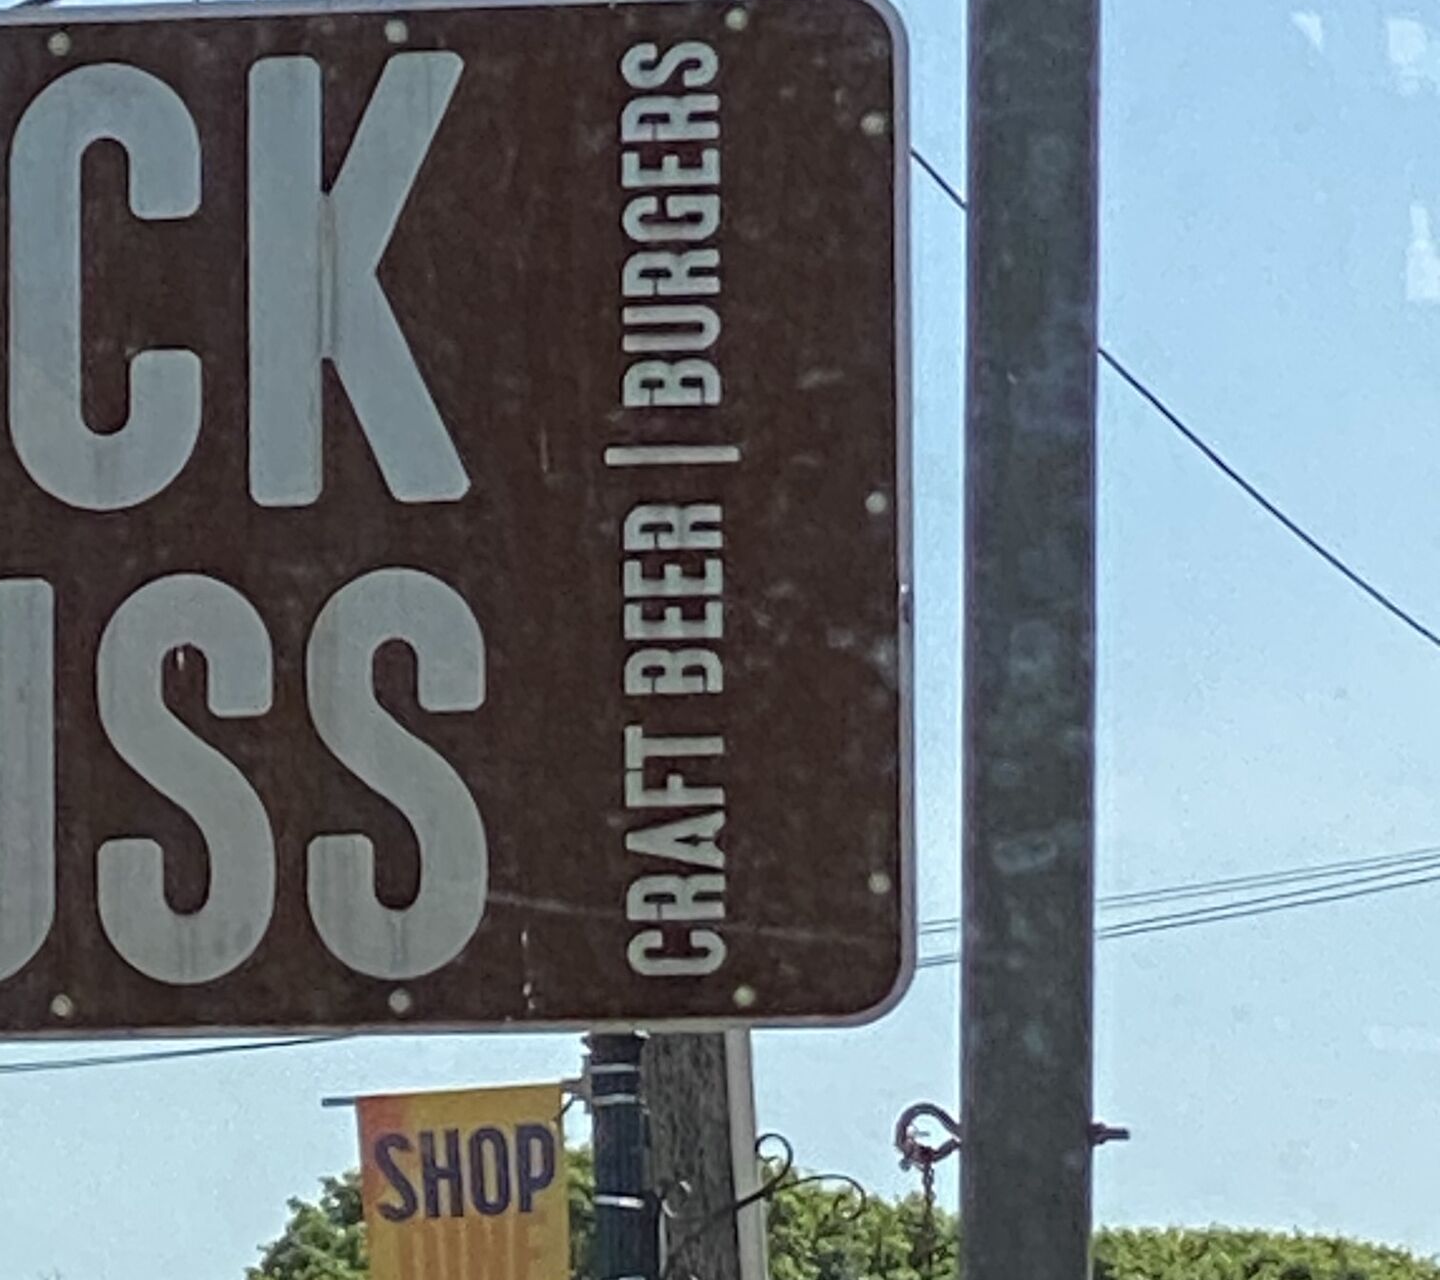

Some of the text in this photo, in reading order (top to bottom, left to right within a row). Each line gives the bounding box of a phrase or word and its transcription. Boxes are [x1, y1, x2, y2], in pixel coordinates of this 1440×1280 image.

[620, 41, 722, 407] BURGERS
[623, 503, 725, 696] BEER
[624, 726, 728, 977] CRAFT
[374, 1122, 555, 1221] SHOP
